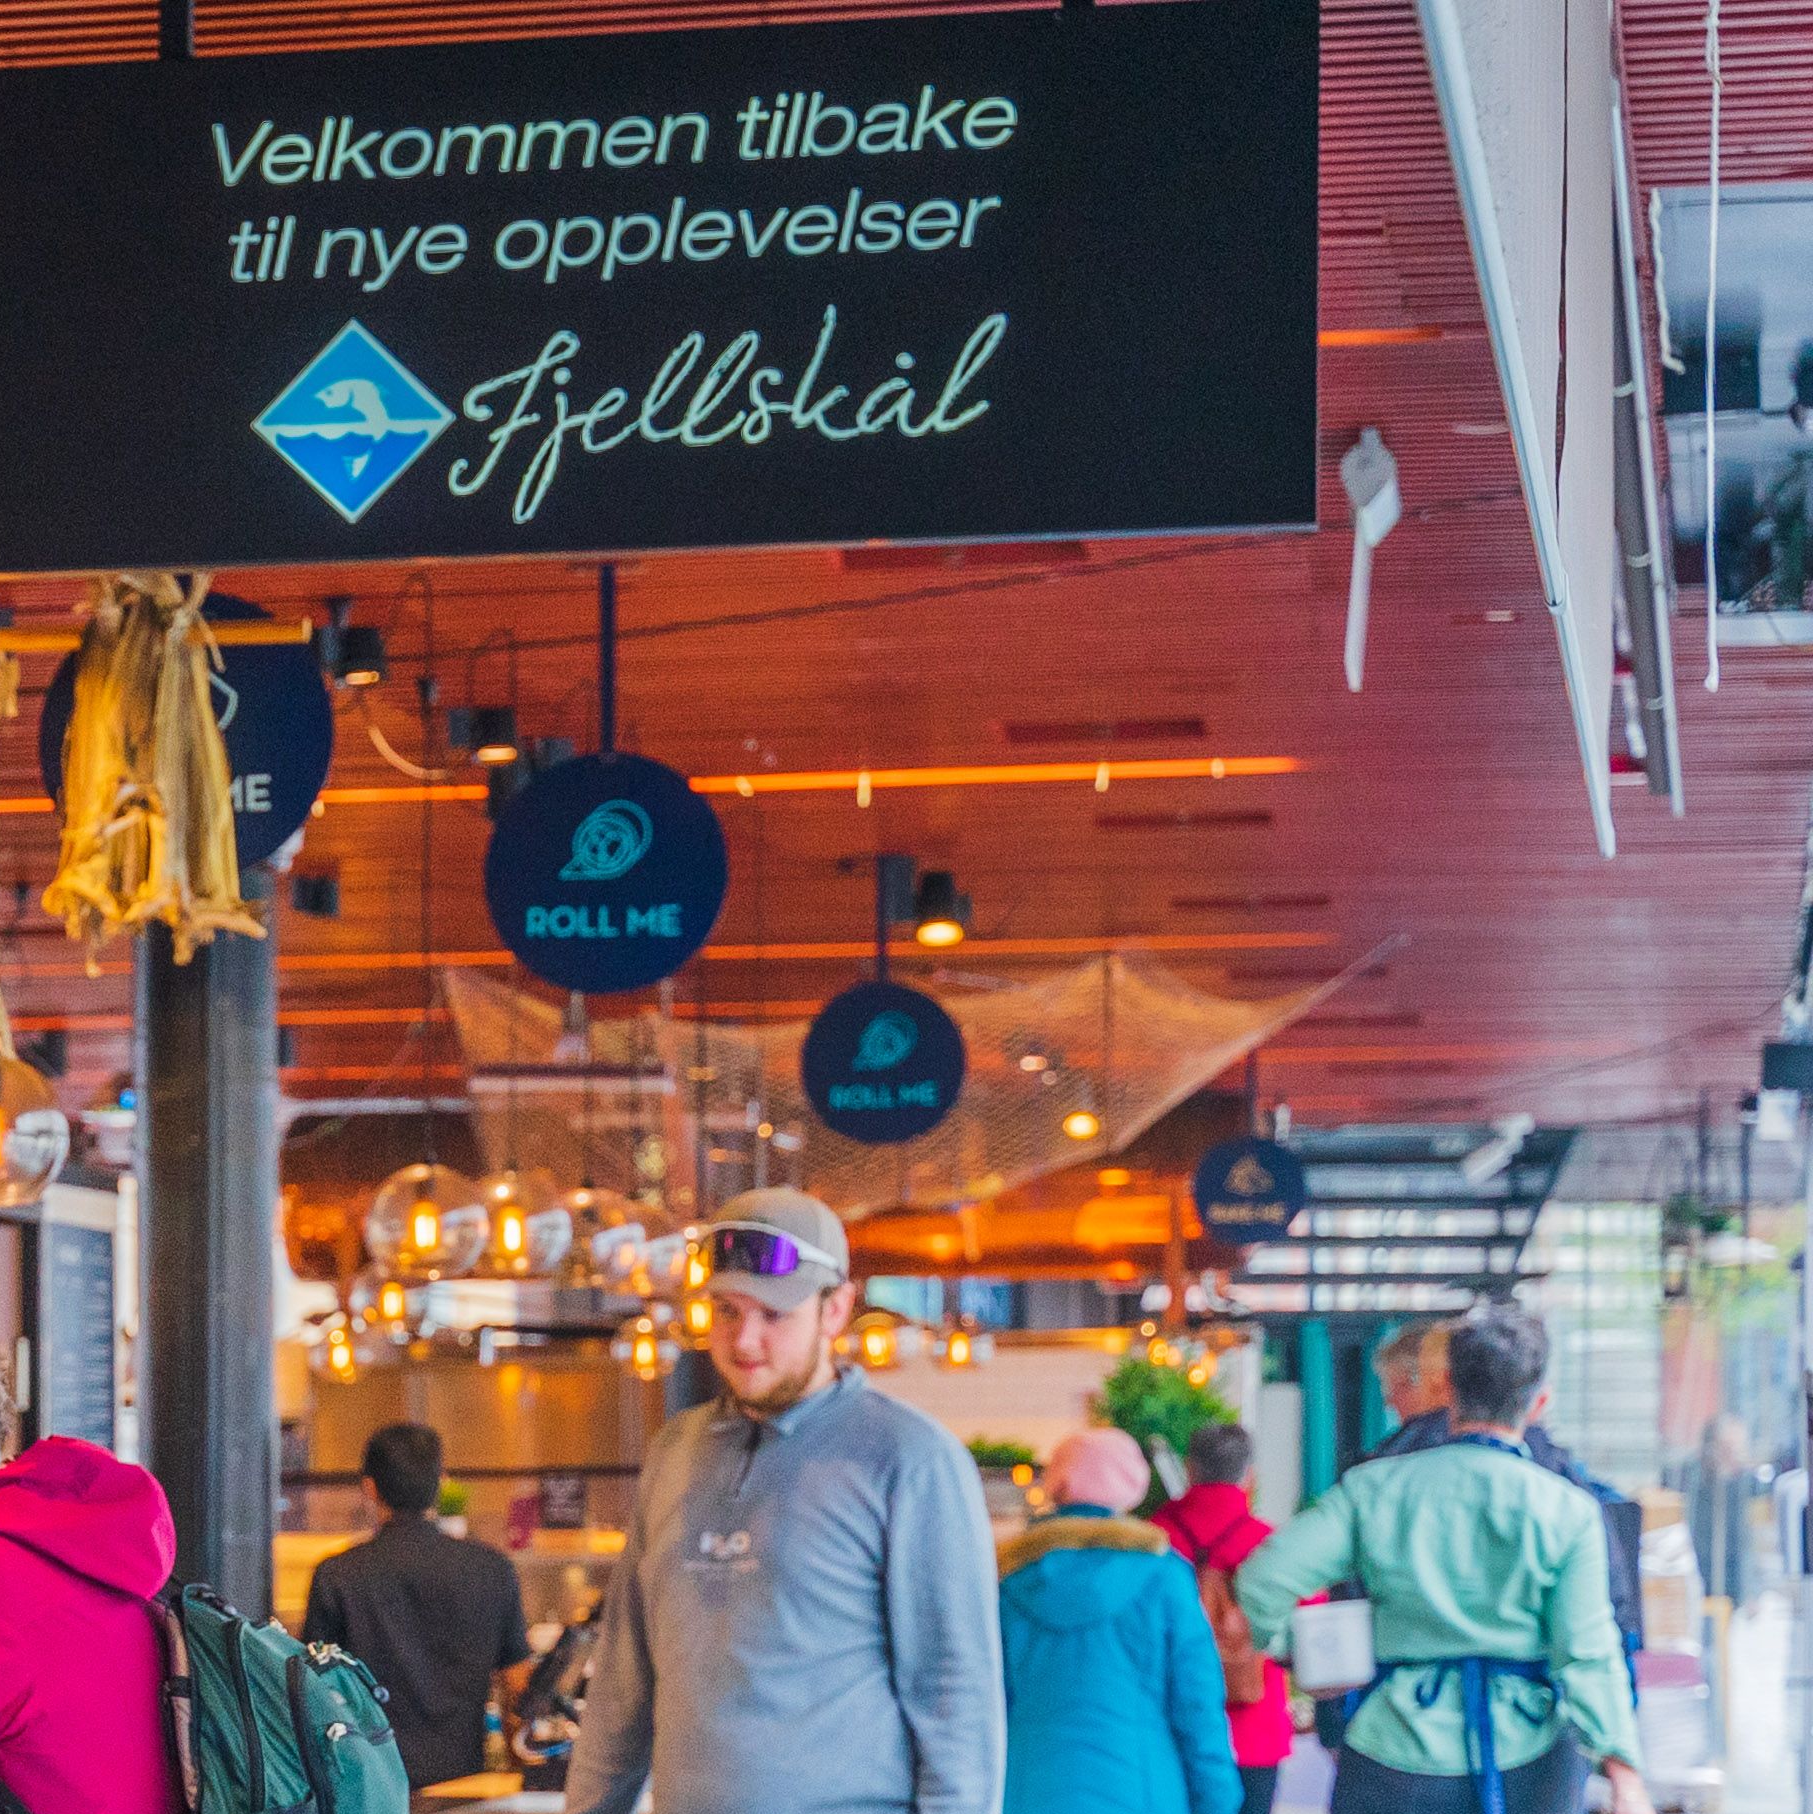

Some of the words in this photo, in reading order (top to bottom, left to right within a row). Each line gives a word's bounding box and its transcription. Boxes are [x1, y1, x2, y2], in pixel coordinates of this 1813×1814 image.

[210, 110, 710, 188] Velkommen
[736, 85, 1018, 160] tilbake
[227, 215, 297, 284] til
[313, 220, 470, 293] nye
[494, 187, 1001, 284] opplevelser
[447, 304, 1009, 525] Fjellskål
[525, 903, 620, 939] ROLL
[626, 903, 684, 938] ME
